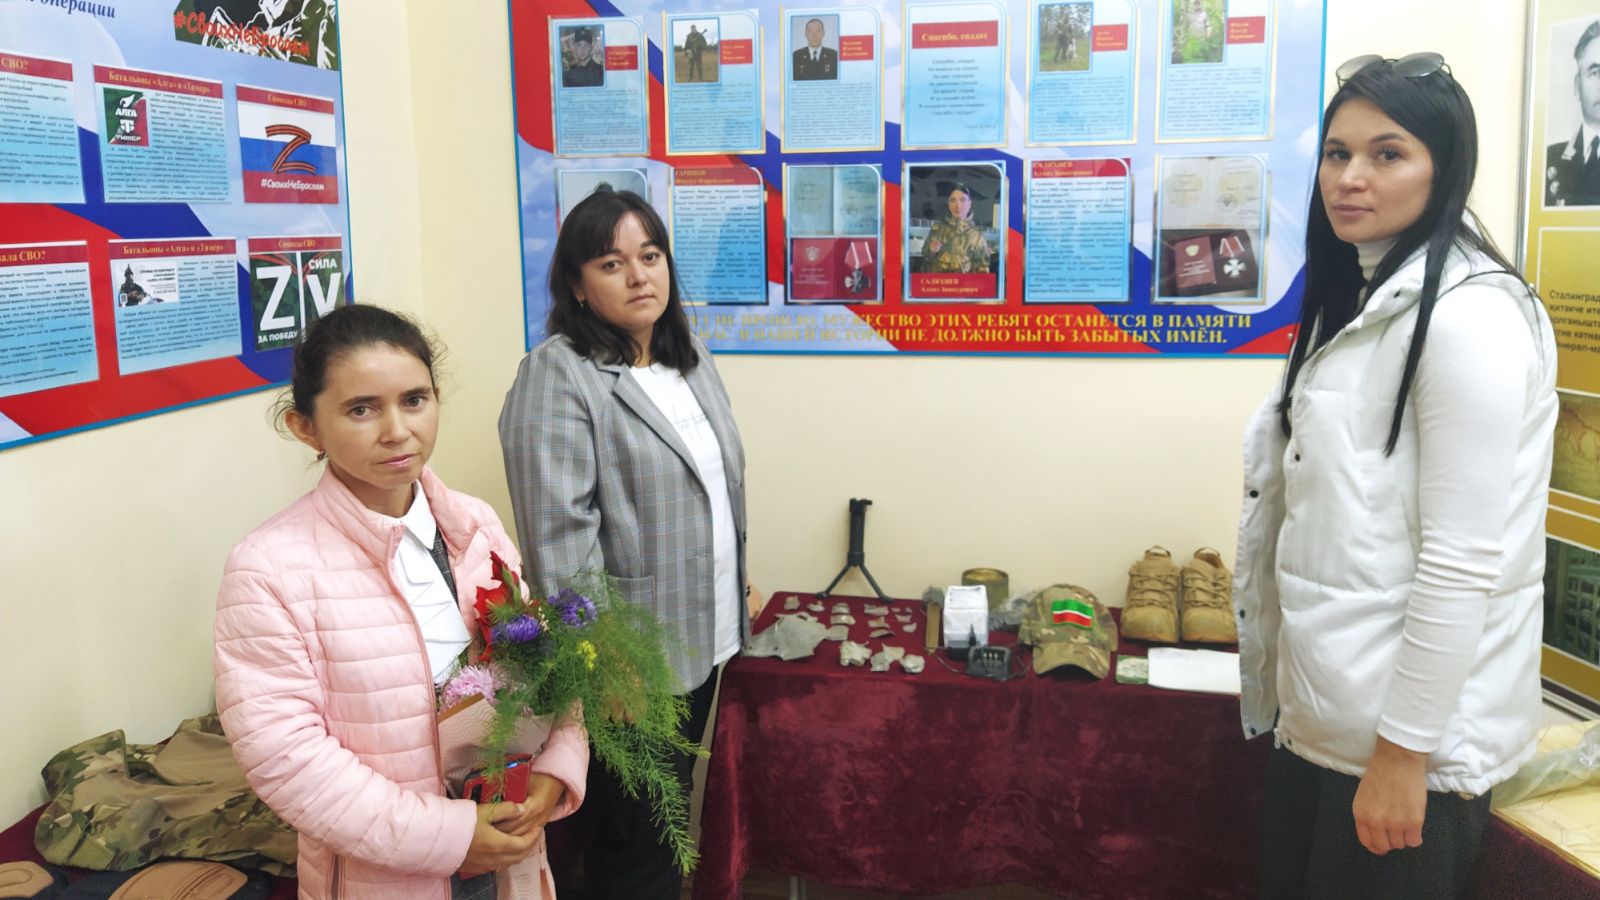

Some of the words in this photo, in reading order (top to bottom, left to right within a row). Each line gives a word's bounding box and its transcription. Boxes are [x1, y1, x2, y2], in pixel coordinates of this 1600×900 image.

[115, 107, 137, 118] АЛГА
[123, 245, 164, 255] Батальоны
[308, 258, 338, 270] СИЛА
[823, 313, 922, 327] МУЖЕСТВО
[929, 313, 973, 327] ЭТИХ
[976, 313, 1032, 327] РЕБЯТ
[1035, 313, 1147, 328] ОСТАНЕТСЯ
[1152, 314, 1164, 328] В
[1168, 314, 1252, 328] ПАМЯТИ
[257, 334, 268, 344] ЗА
[269, 330, 298, 342] ПОБЕДУ
[905, 328, 928, 342] НЕ
[931, 328, 1011, 343] ДОЛЖНО
[1015, 328, 1066, 342] БЫТЬ
[1071, 329, 1161, 343] ЗАБЫТЫХ
[1166, 326, 1228, 343] ИМЁН.
